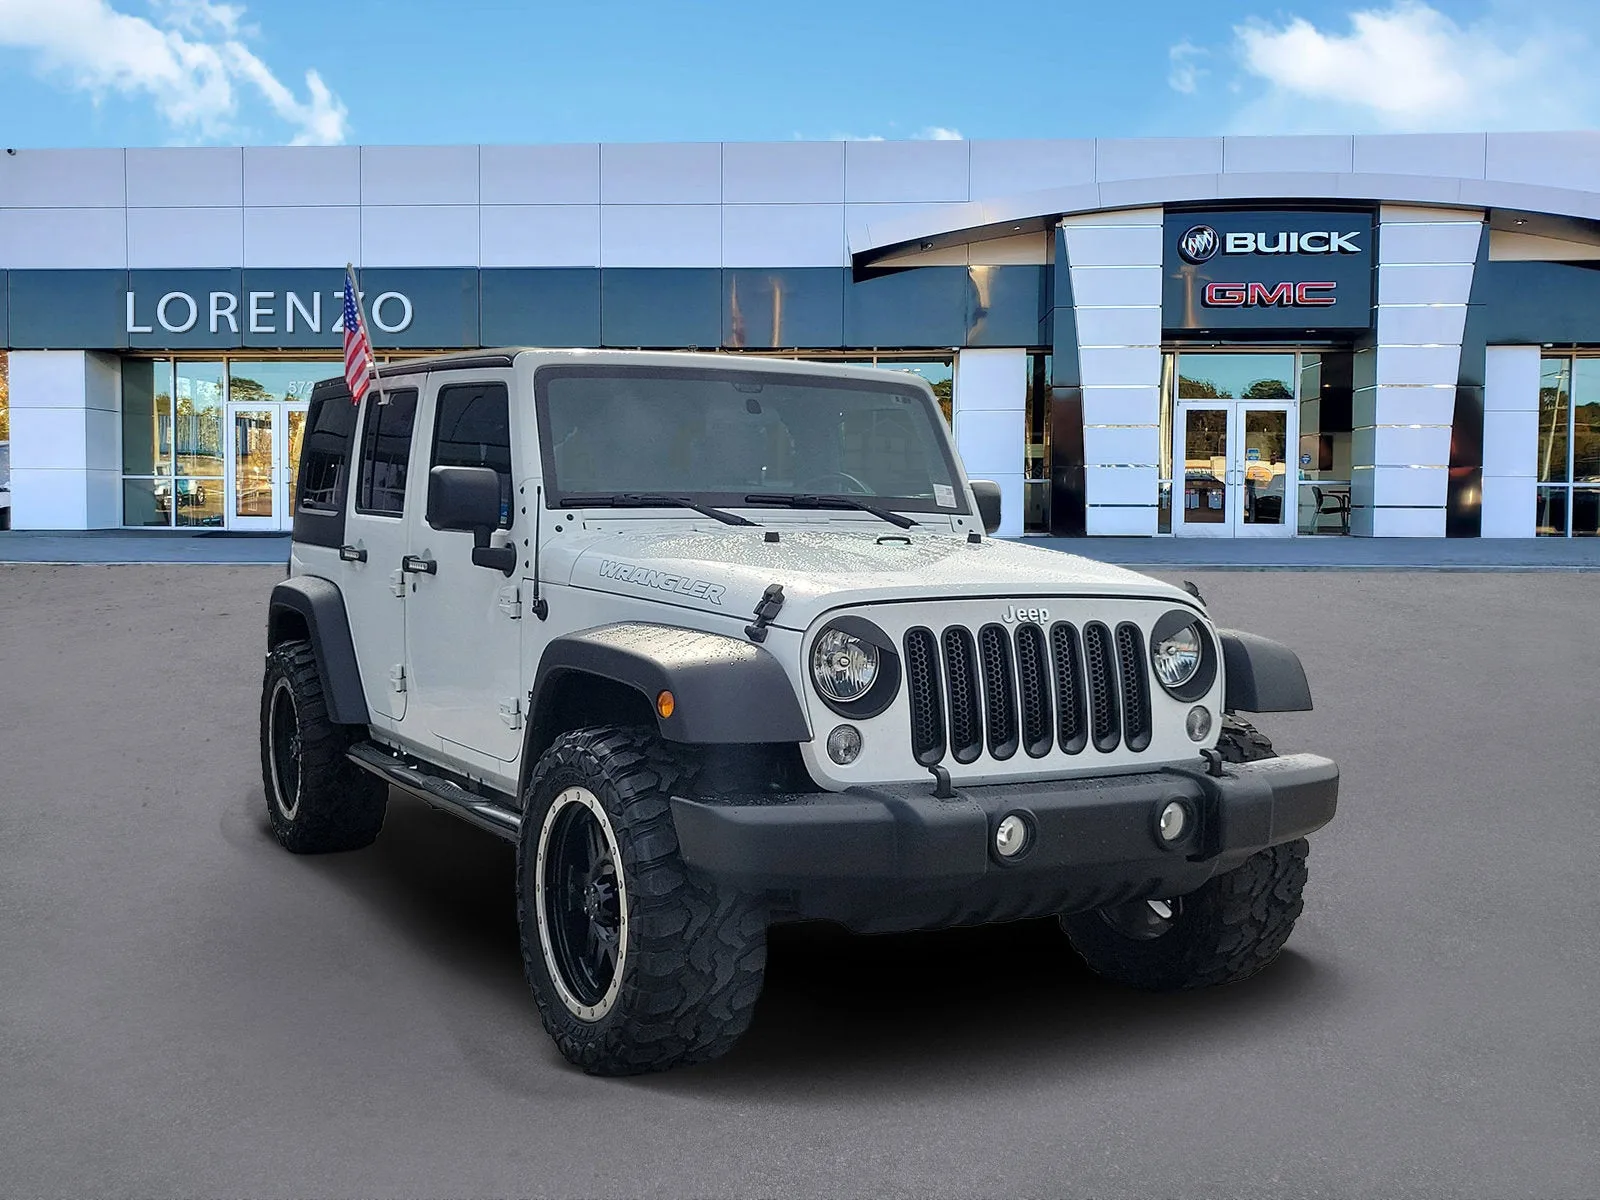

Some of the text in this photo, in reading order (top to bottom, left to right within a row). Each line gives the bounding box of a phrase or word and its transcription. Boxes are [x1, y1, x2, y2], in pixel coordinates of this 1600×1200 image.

[1225, 231, 1362, 253] BUICK
[1205, 282, 1337, 305] GMC
[600, 560, 726, 605] WRANGLER
[1002, 605, 1050, 625] Jeep
